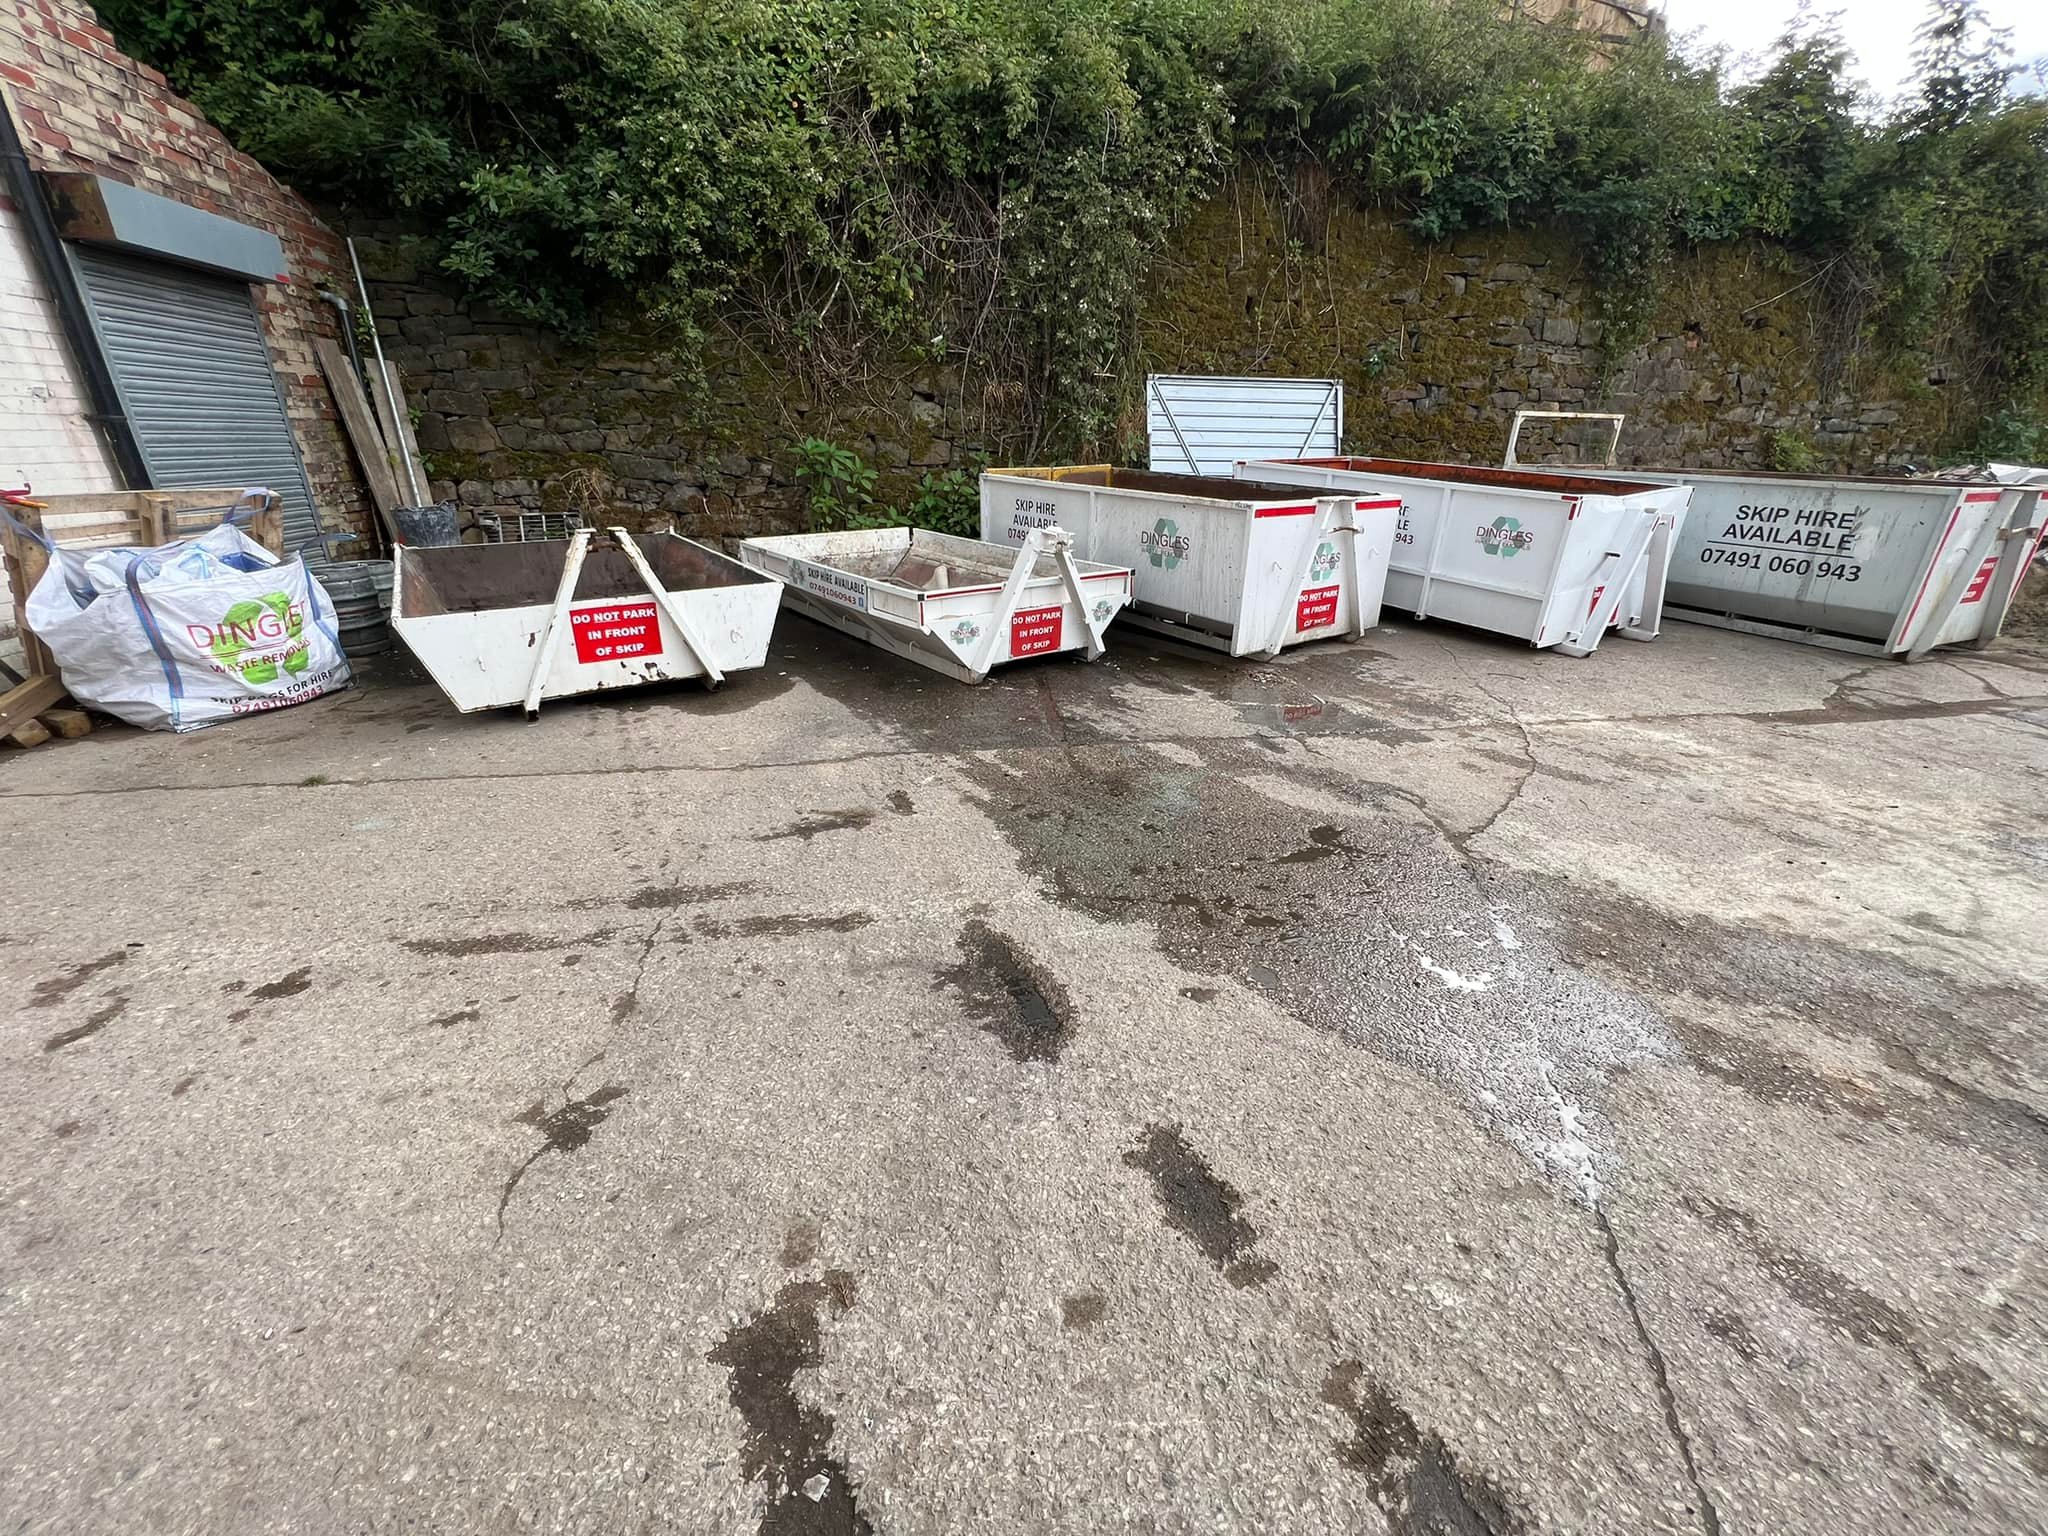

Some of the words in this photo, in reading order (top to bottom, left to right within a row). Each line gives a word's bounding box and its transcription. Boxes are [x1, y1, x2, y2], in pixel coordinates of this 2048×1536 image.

[1015, 499, 1034, 512] SKIP
[1036, 501, 1056, 516] HIRE
[1735, 504, 1789, 524] SKIP
[1794, 509, 1857, 530] HIRE
[1140, 530, 1190, 551] DINGLES
[1395, 532, 1414, 545] 943
[1476, 526, 1534, 544] DINGLES
[1722, 523, 1855, 551] AVAILABLE
[1701, 548, 1762, 570] 07491
[1768, 556, 1811, 576] 060
[1816, 561, 1862, 583] 943
[834, 576, 865, 596] AVAILABLE
[1309, 592, 1323, 602] NOT
[1322, 589, 1338, 599] PARK
[572, 615, 591, 625] DO
[593, 611, 621, 624] NOT
[622, 608, 656, 619] PARK
[1303, 607, 1310, 615] IN
[1310, 603, 1331, 614] FRONT
[1012, 616, 1024, 625] DO
[1025, 613, 1041, 625] NOT
[1041, 610, 1062, 621] PARK
[587, 630, 602, 640] IN
[604, 625, 647, 638] FRONT
[1019, 630, 1028, 638] IN
[1029, 625, 1054, 637] FRONT
[595, 646, 612, 656] OF
[615, 643, 645, 654] SKIP
[1021, 642, 1033, 652] OF
[1033, 639, 1051, 650] SKIP
[210, 657, 258, 674] WASTE
[286, 681, 308, 696] FOR
